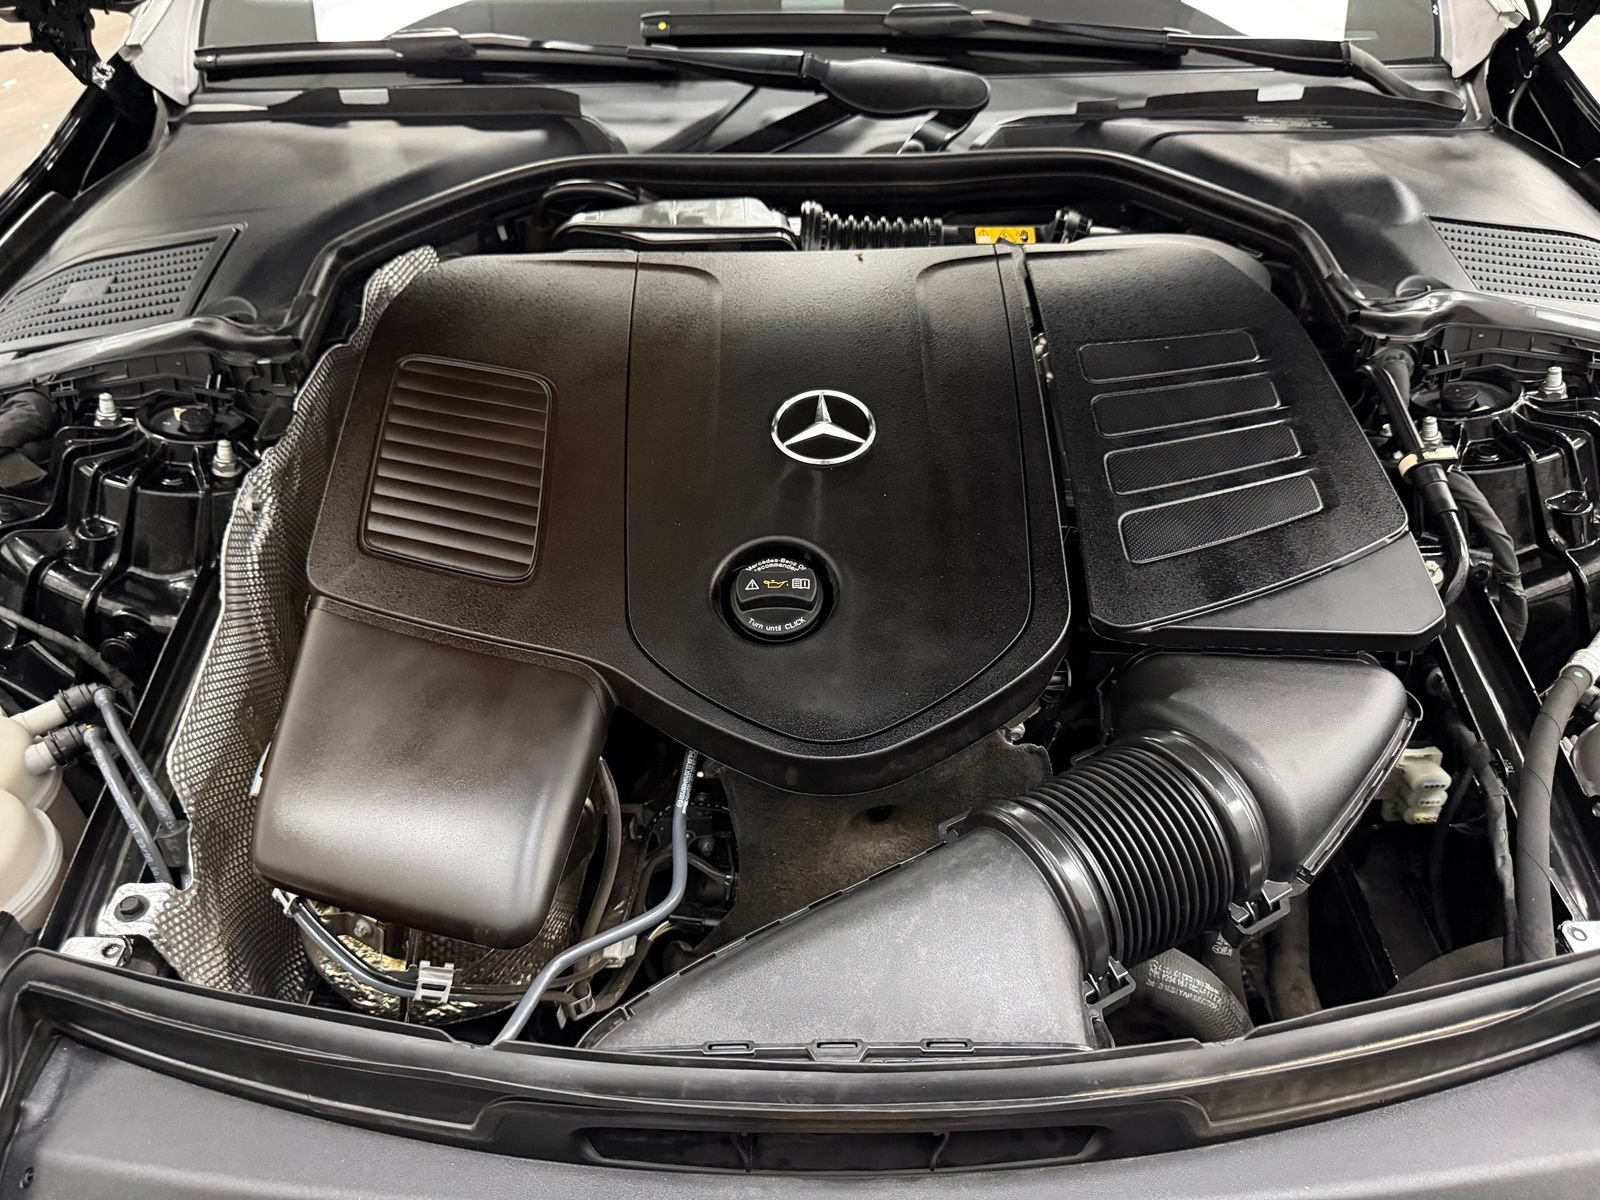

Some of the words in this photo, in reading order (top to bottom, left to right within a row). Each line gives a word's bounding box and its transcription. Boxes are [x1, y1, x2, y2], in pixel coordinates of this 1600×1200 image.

[748, 617, 764, 630] Turn
[765, 624, 782, 632] until
[784, 616, 806, 631] CLICK
